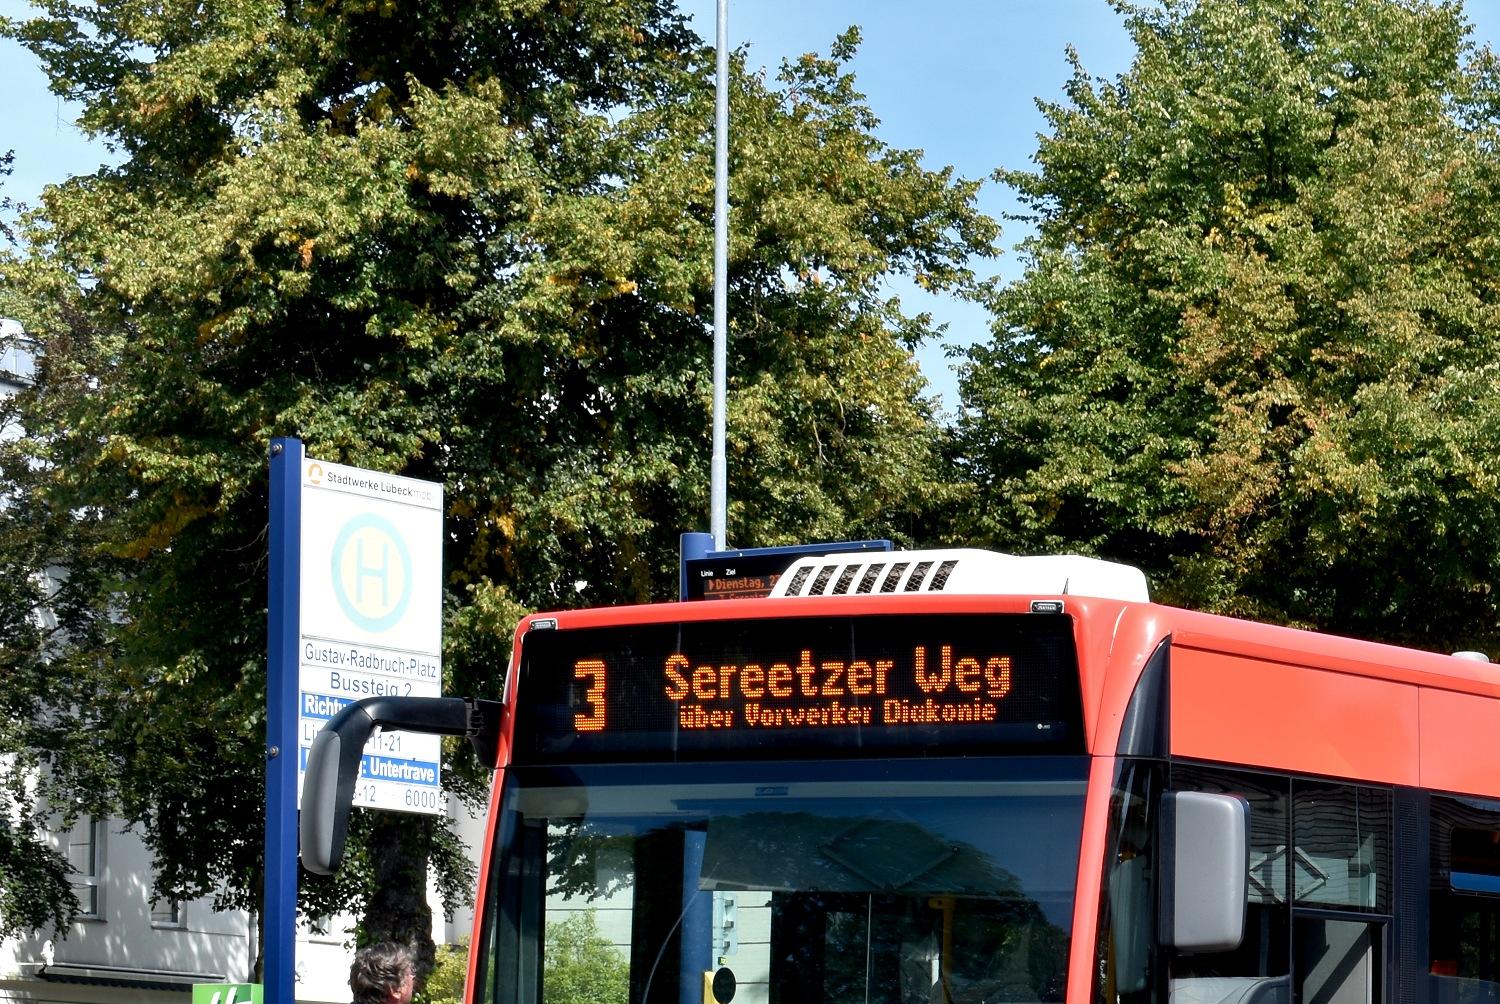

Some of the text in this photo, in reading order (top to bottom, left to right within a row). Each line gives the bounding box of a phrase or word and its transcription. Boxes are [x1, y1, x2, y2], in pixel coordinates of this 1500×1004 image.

[328, 472, 379, 491] Stadtwerke
[381, 482, 413, 498] Lübeck
[716, 578, 765, 590] Dienstag,
[305, 643, 437, 678] Gustav-Radbruch-Platz
[331, 672, 412, 697] Bussteig 2
[574, 645, 1011, 731] 3 Sereetzer Weg
[680, 697, 997, 728] über Vorwerker Diakonie
[370, 756, 435, 783] Untertrave
[405, 789, 436, 808] 6000
